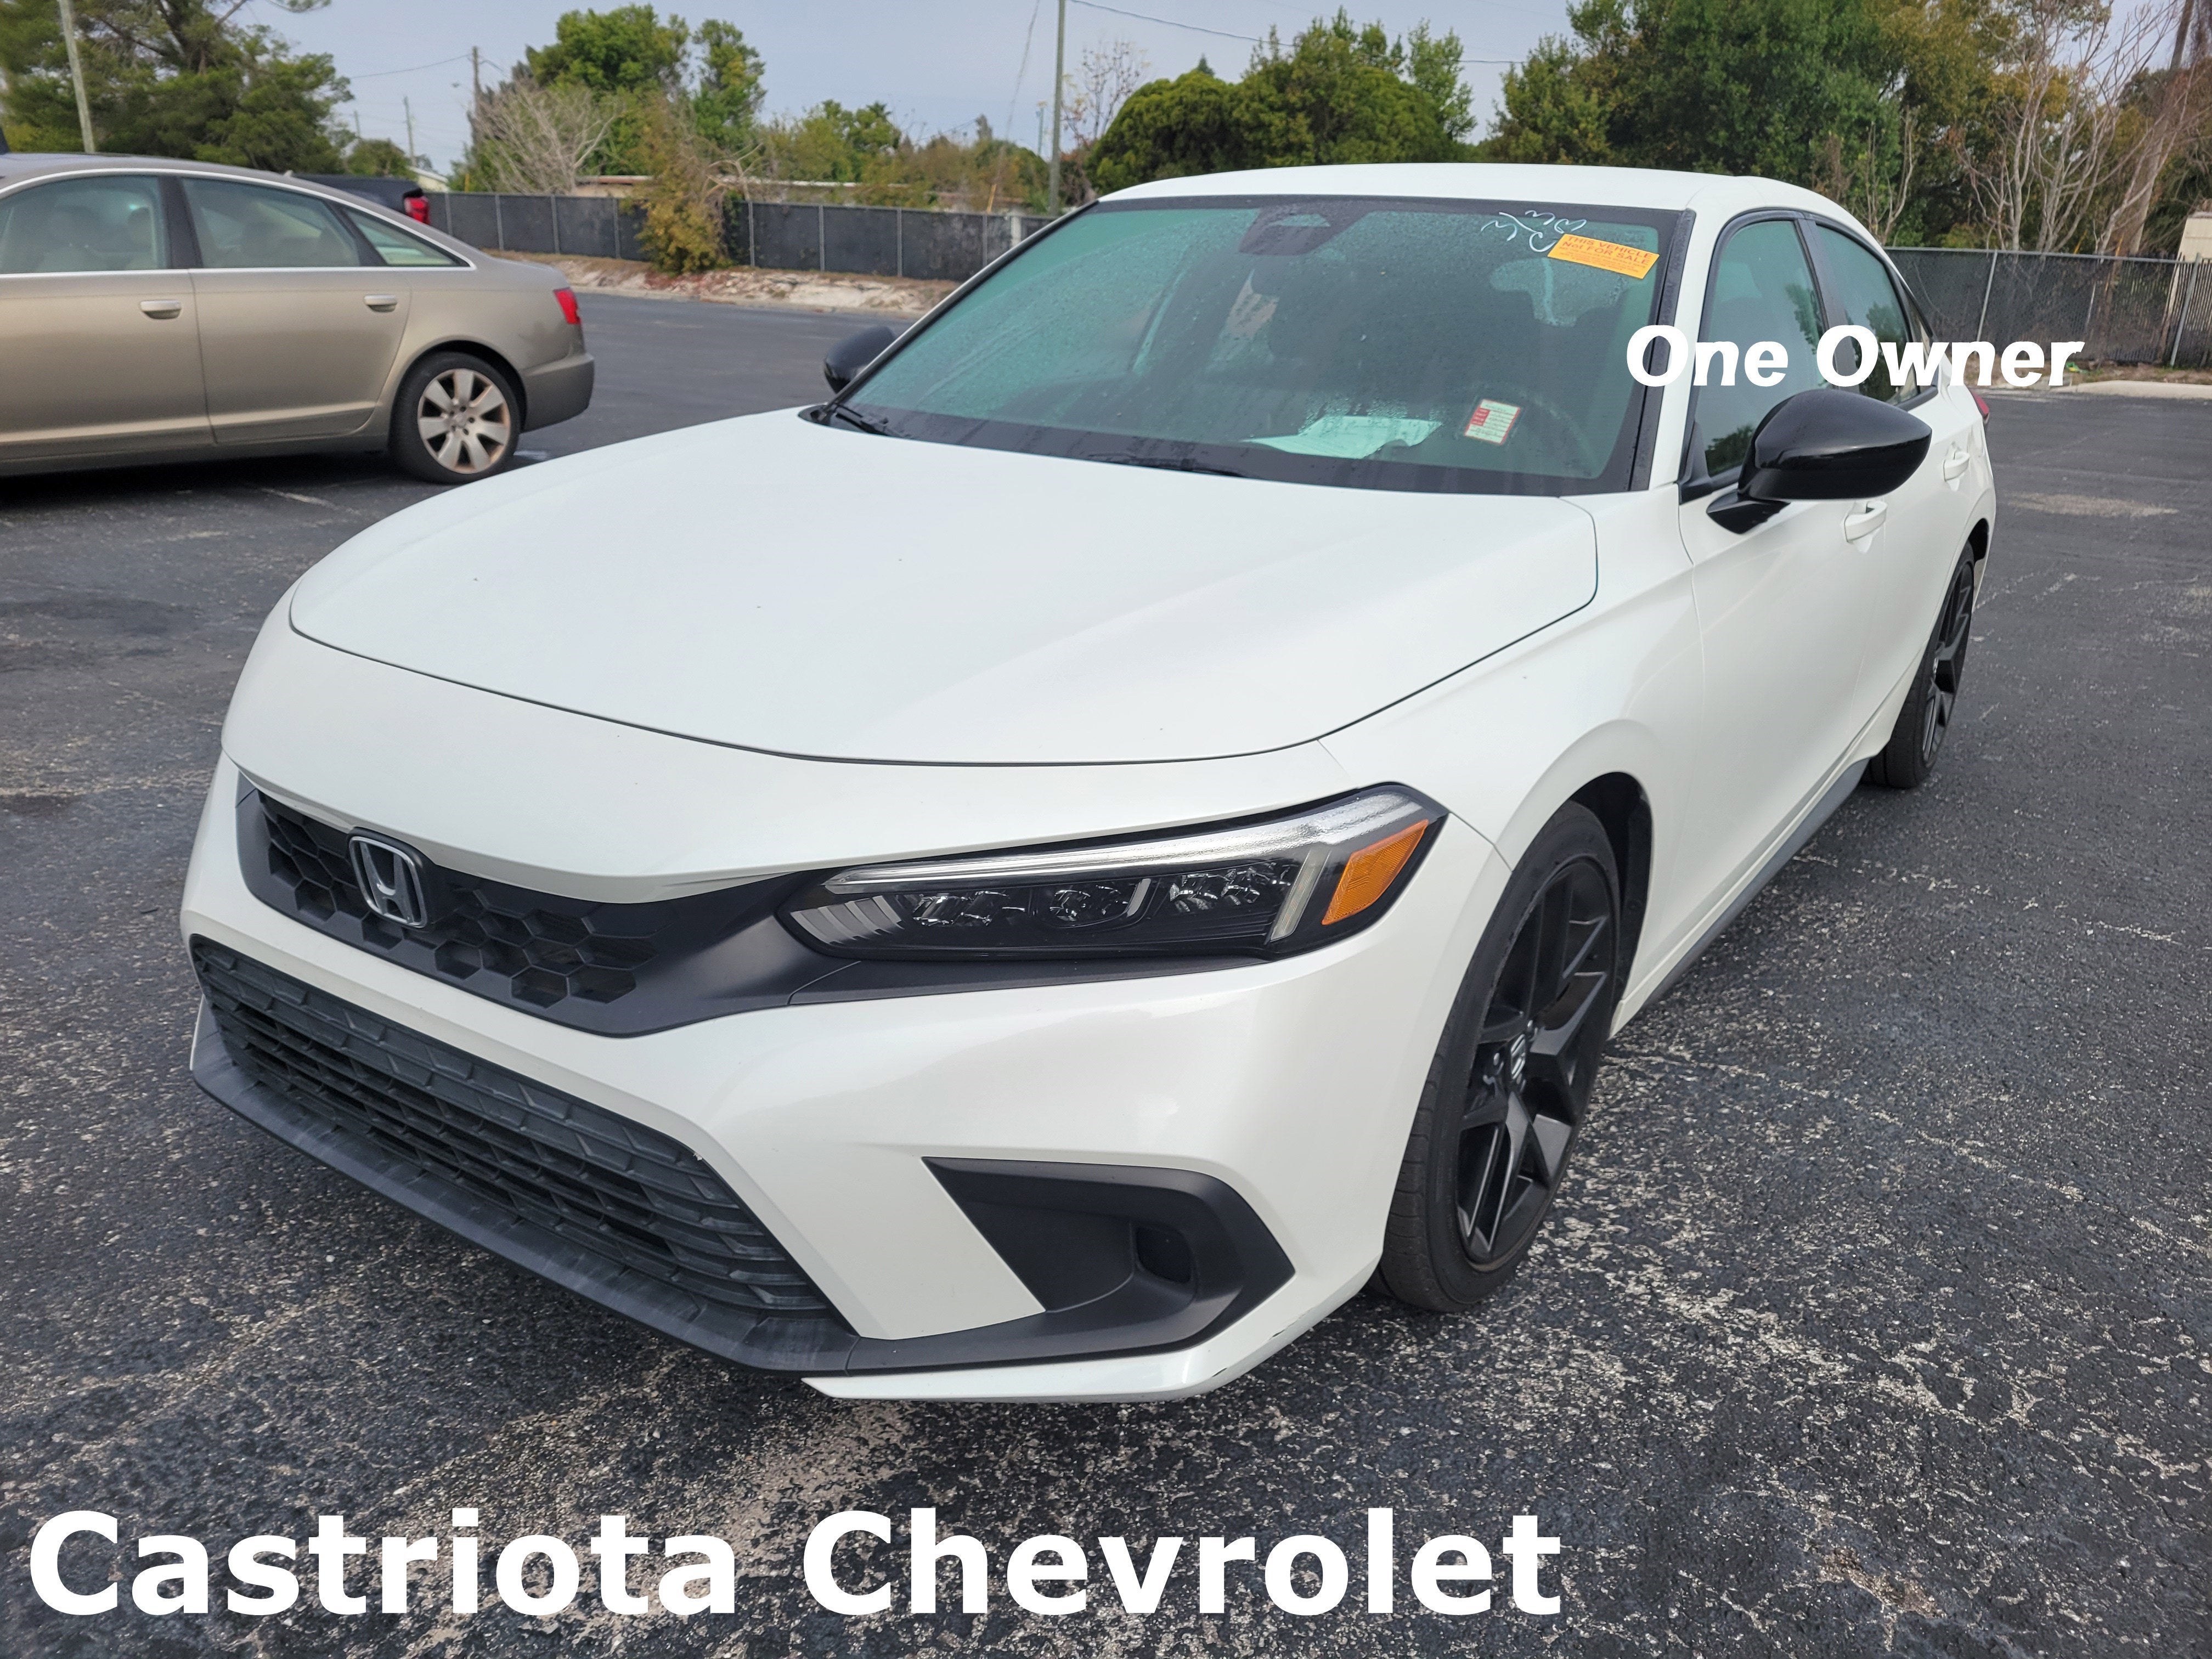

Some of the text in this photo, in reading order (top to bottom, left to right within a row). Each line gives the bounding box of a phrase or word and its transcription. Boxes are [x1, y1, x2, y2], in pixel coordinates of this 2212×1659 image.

[1567, 236, 1594, 245] THIS
[1599, 242, 1652, 259] VEHICLE
[1586, 246, 1612, 256] FOR
[1616, 252, 1650, 264] SALE
